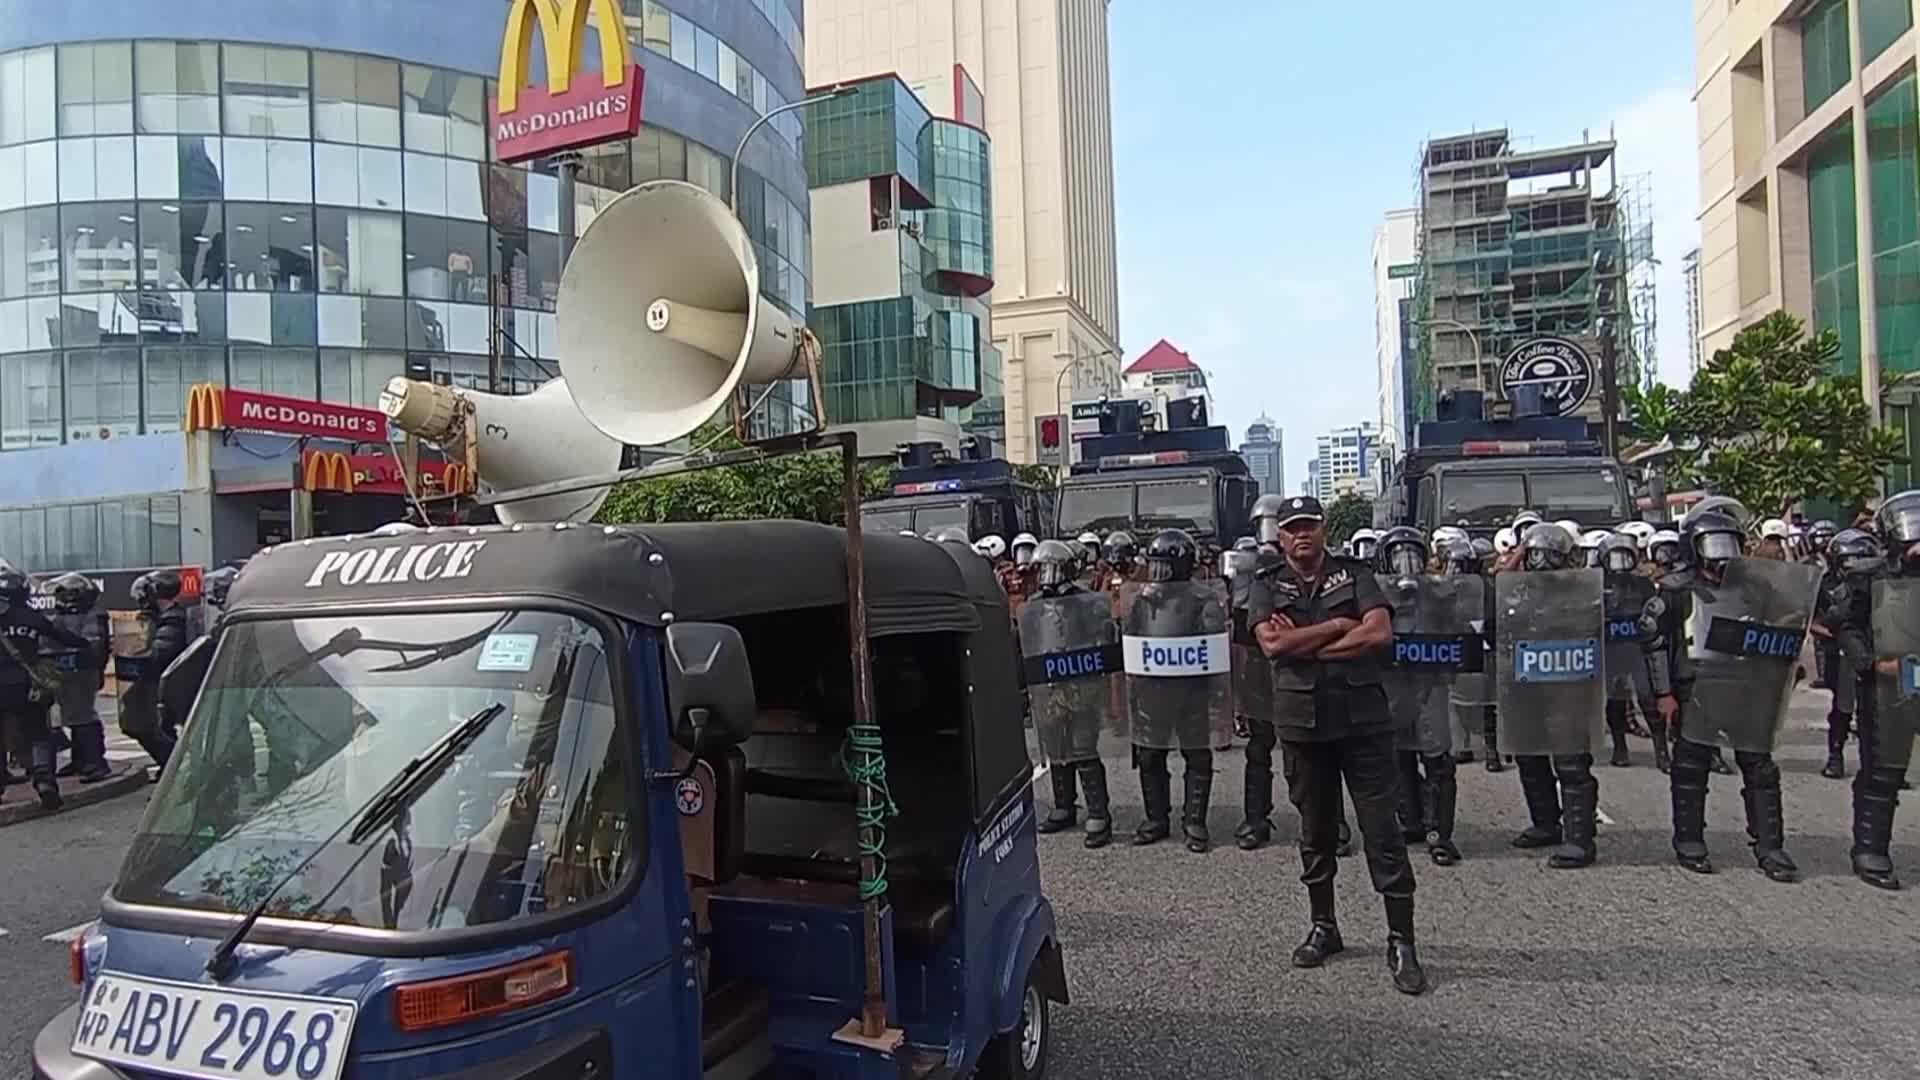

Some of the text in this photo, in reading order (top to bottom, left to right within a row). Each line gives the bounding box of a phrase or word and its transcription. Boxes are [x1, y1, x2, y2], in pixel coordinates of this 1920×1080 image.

[497, 95, 628, 141] McDonald's
[1517, 344, 1556, 363] Coffee
[241, 402, 377, 432] McDonald's
[304, 540, 487, 588] POLICE
[1609, 622, 1637, 637] POL
[1045, 652, 1104, 677] POLICE
[1143, 646, 1208, 666] POLICE
[1396, 643, 1462, 662] POLICE
[1523, 648, 1594, 673] POLICE
[109, 989, 202, 1062] ABV
[200, 1003, 336, 1080] 2968
